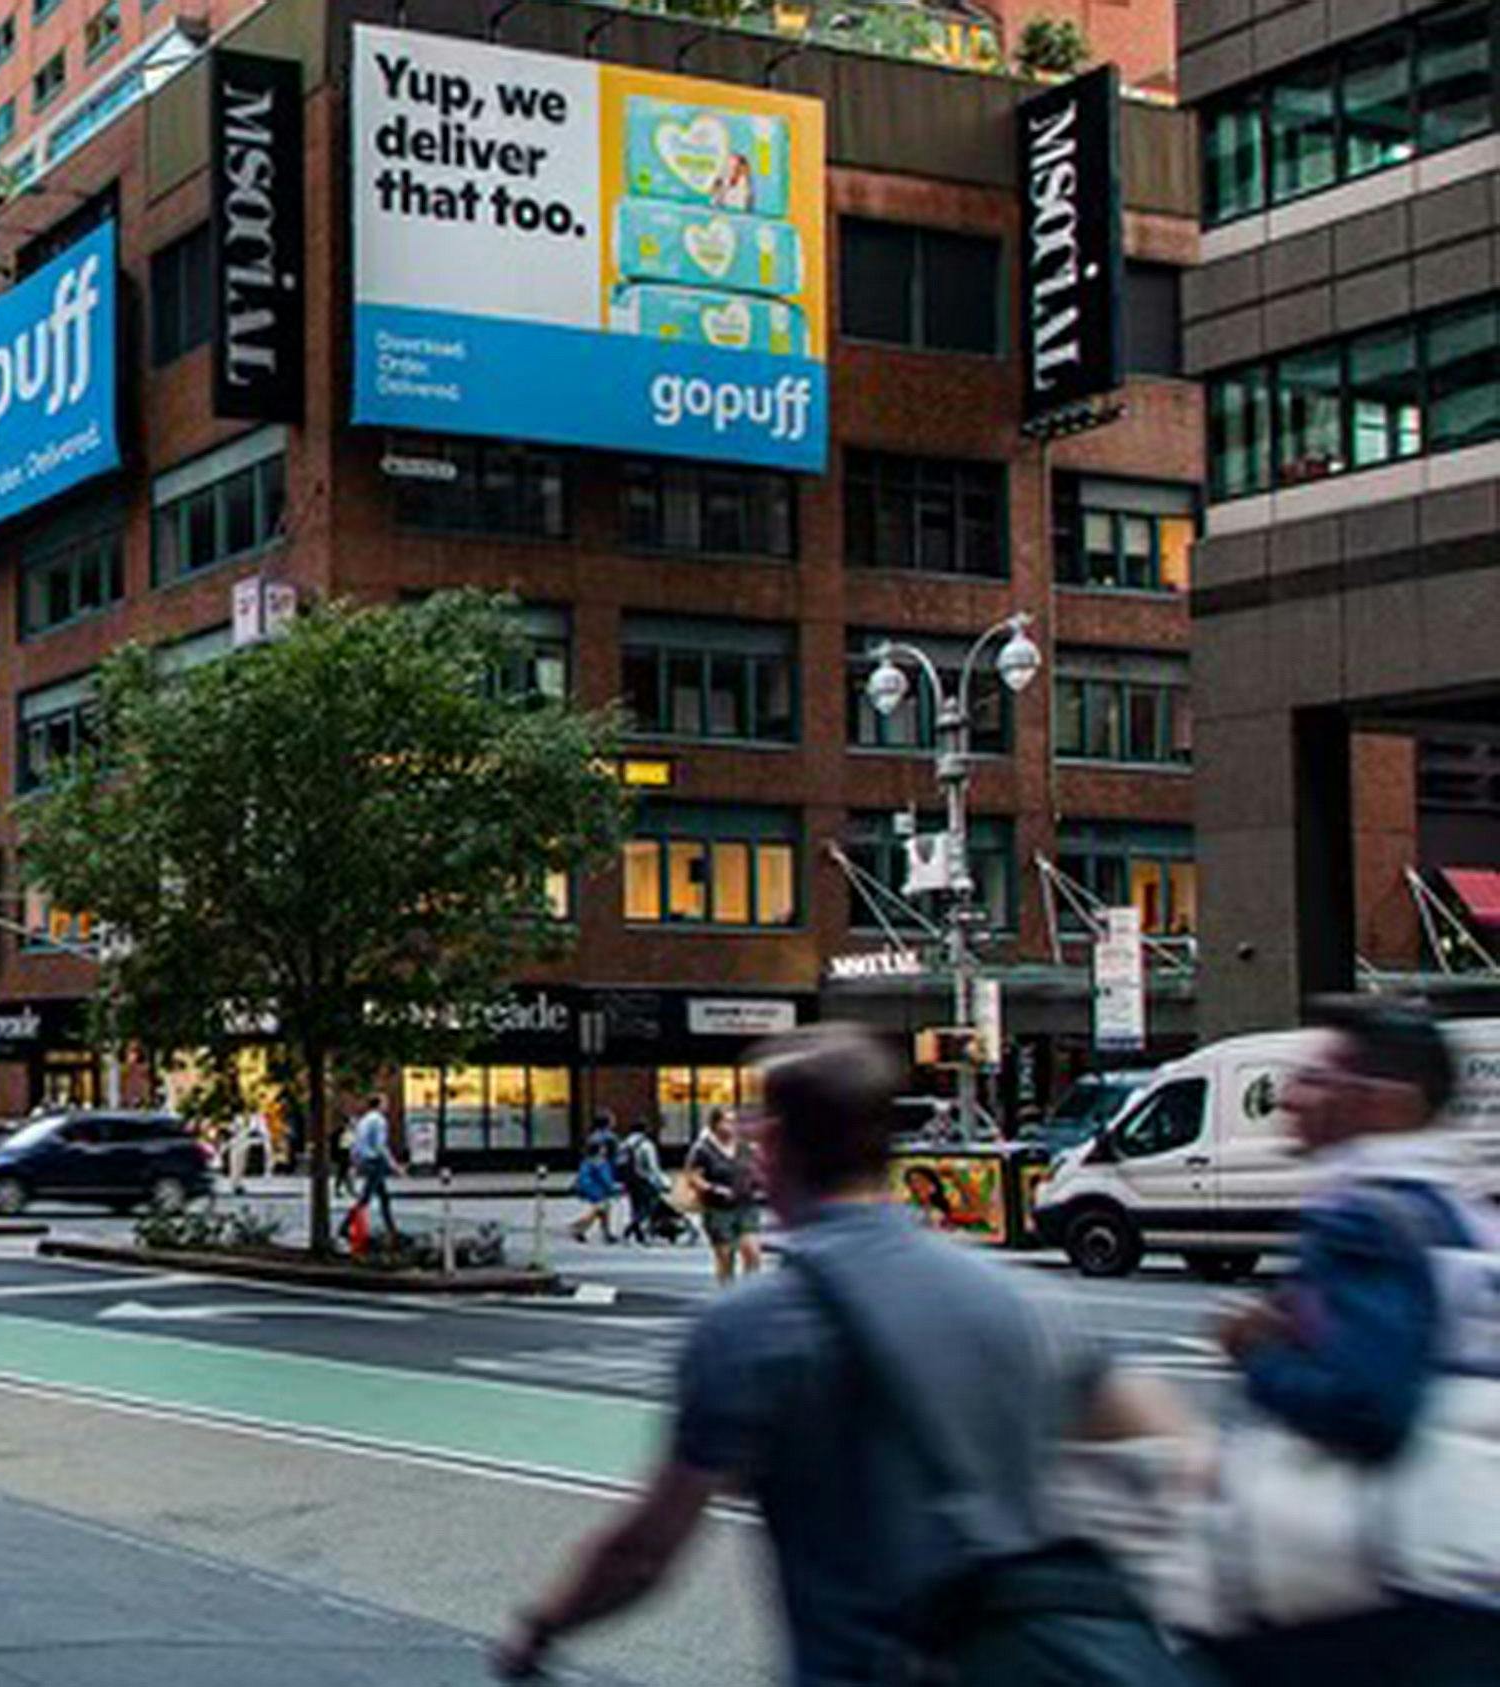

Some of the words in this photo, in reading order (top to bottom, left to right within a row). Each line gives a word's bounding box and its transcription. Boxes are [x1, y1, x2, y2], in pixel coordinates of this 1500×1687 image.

[374, 52, 483, 119] Yup,
[497, 83, 567, 124] we
[374, 117, 547, 179] deliver
[374, 168, 483, 221] that
[493, 187, 587, 238] too.
[650, 373, 810, 440] gopuff
